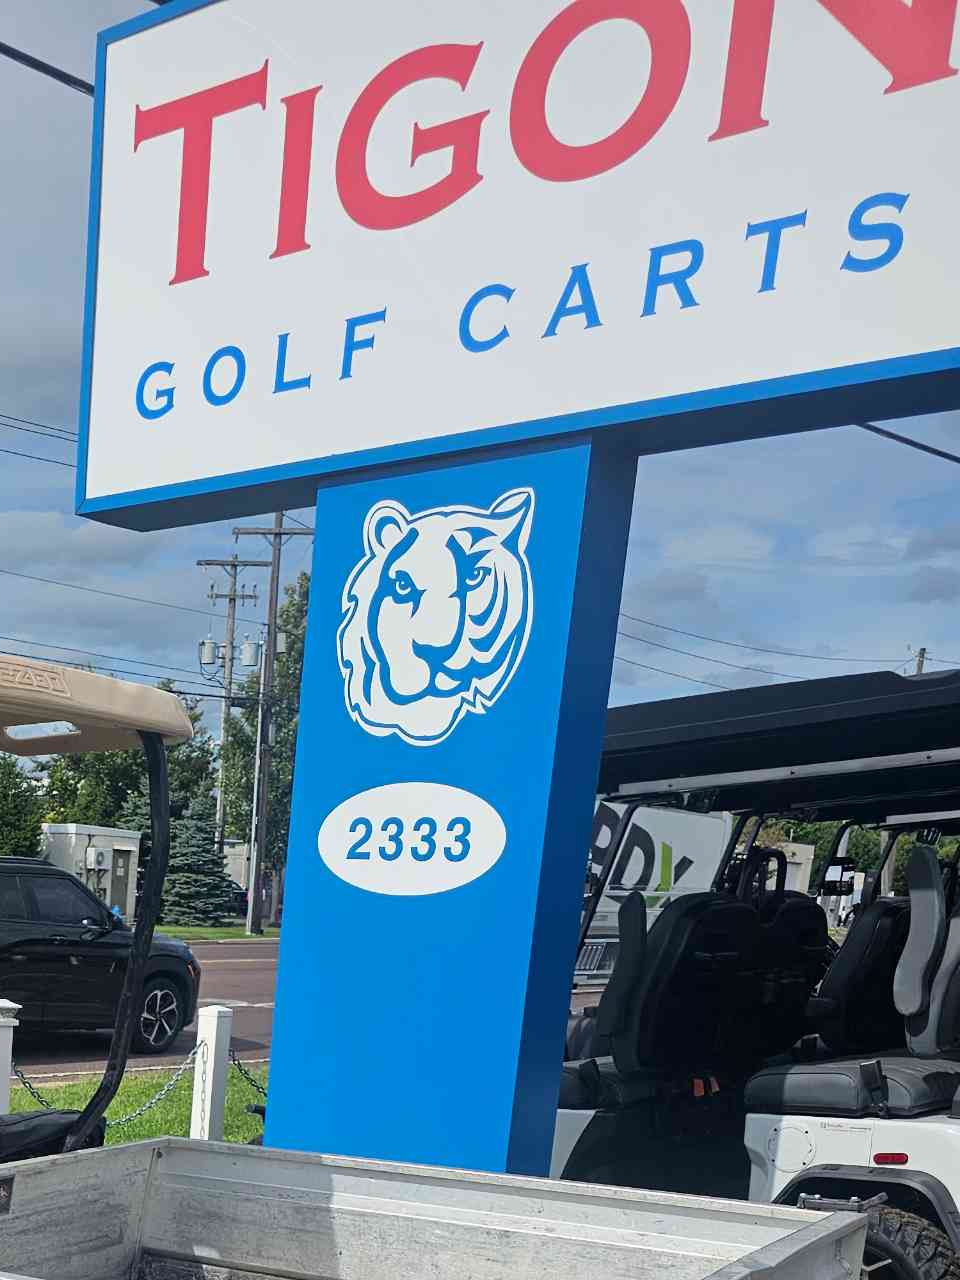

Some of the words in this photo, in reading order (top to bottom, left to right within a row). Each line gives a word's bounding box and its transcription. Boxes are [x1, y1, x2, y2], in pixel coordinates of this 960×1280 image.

[135, 304, 387, 421] GOLF
[458, 192, 910, 353] CARTS
[346, 816, 472, 862] 2333
